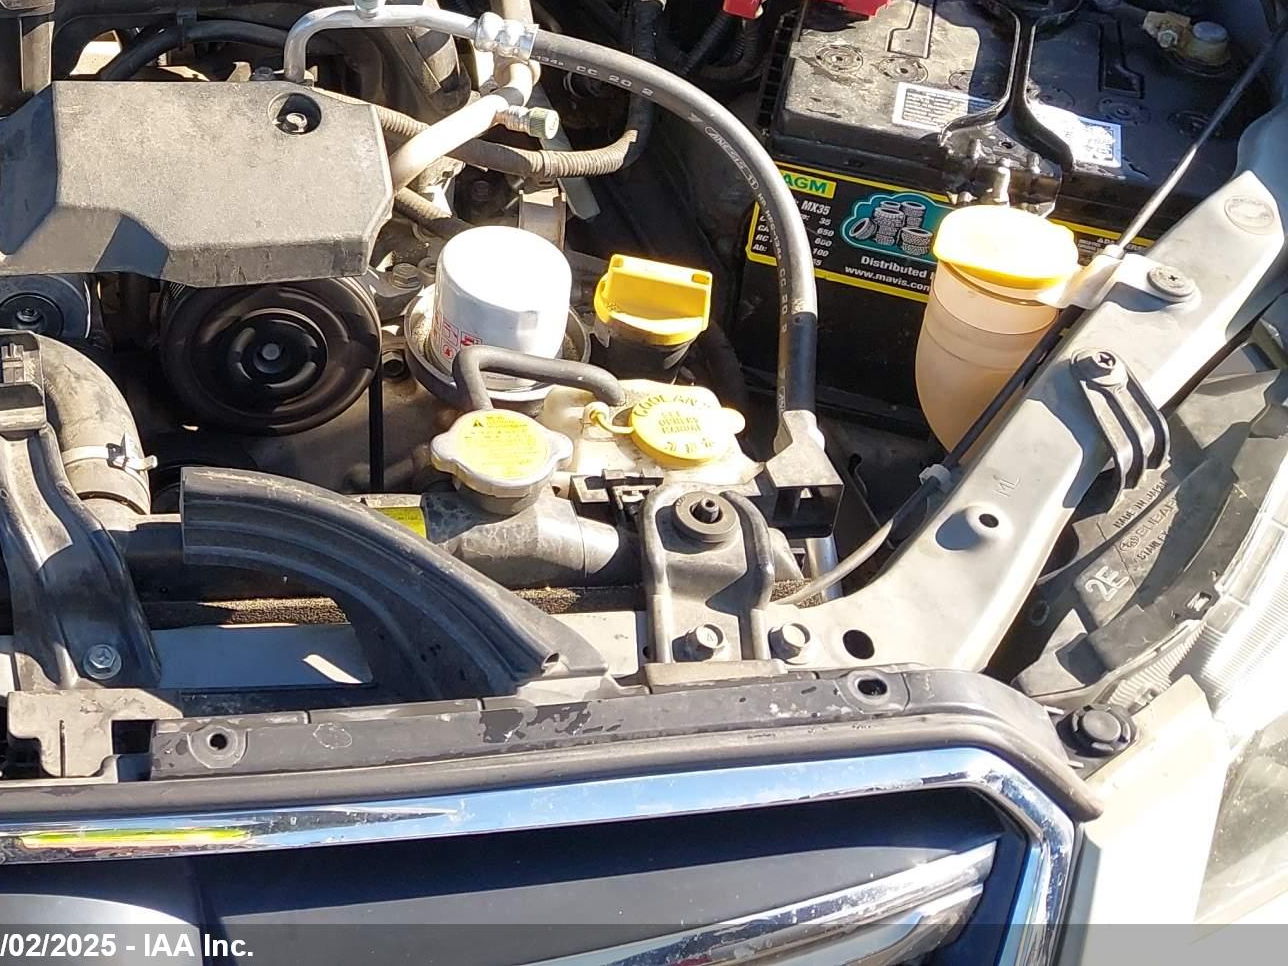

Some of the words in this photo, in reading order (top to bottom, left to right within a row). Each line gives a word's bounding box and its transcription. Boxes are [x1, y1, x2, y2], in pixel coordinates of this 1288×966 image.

[783, 173, 826, 194] AGM
[801, 200, 831, 215] MX35
[819, 217, 831, 226] 35
[861, 255, 927, 278] Distributed
